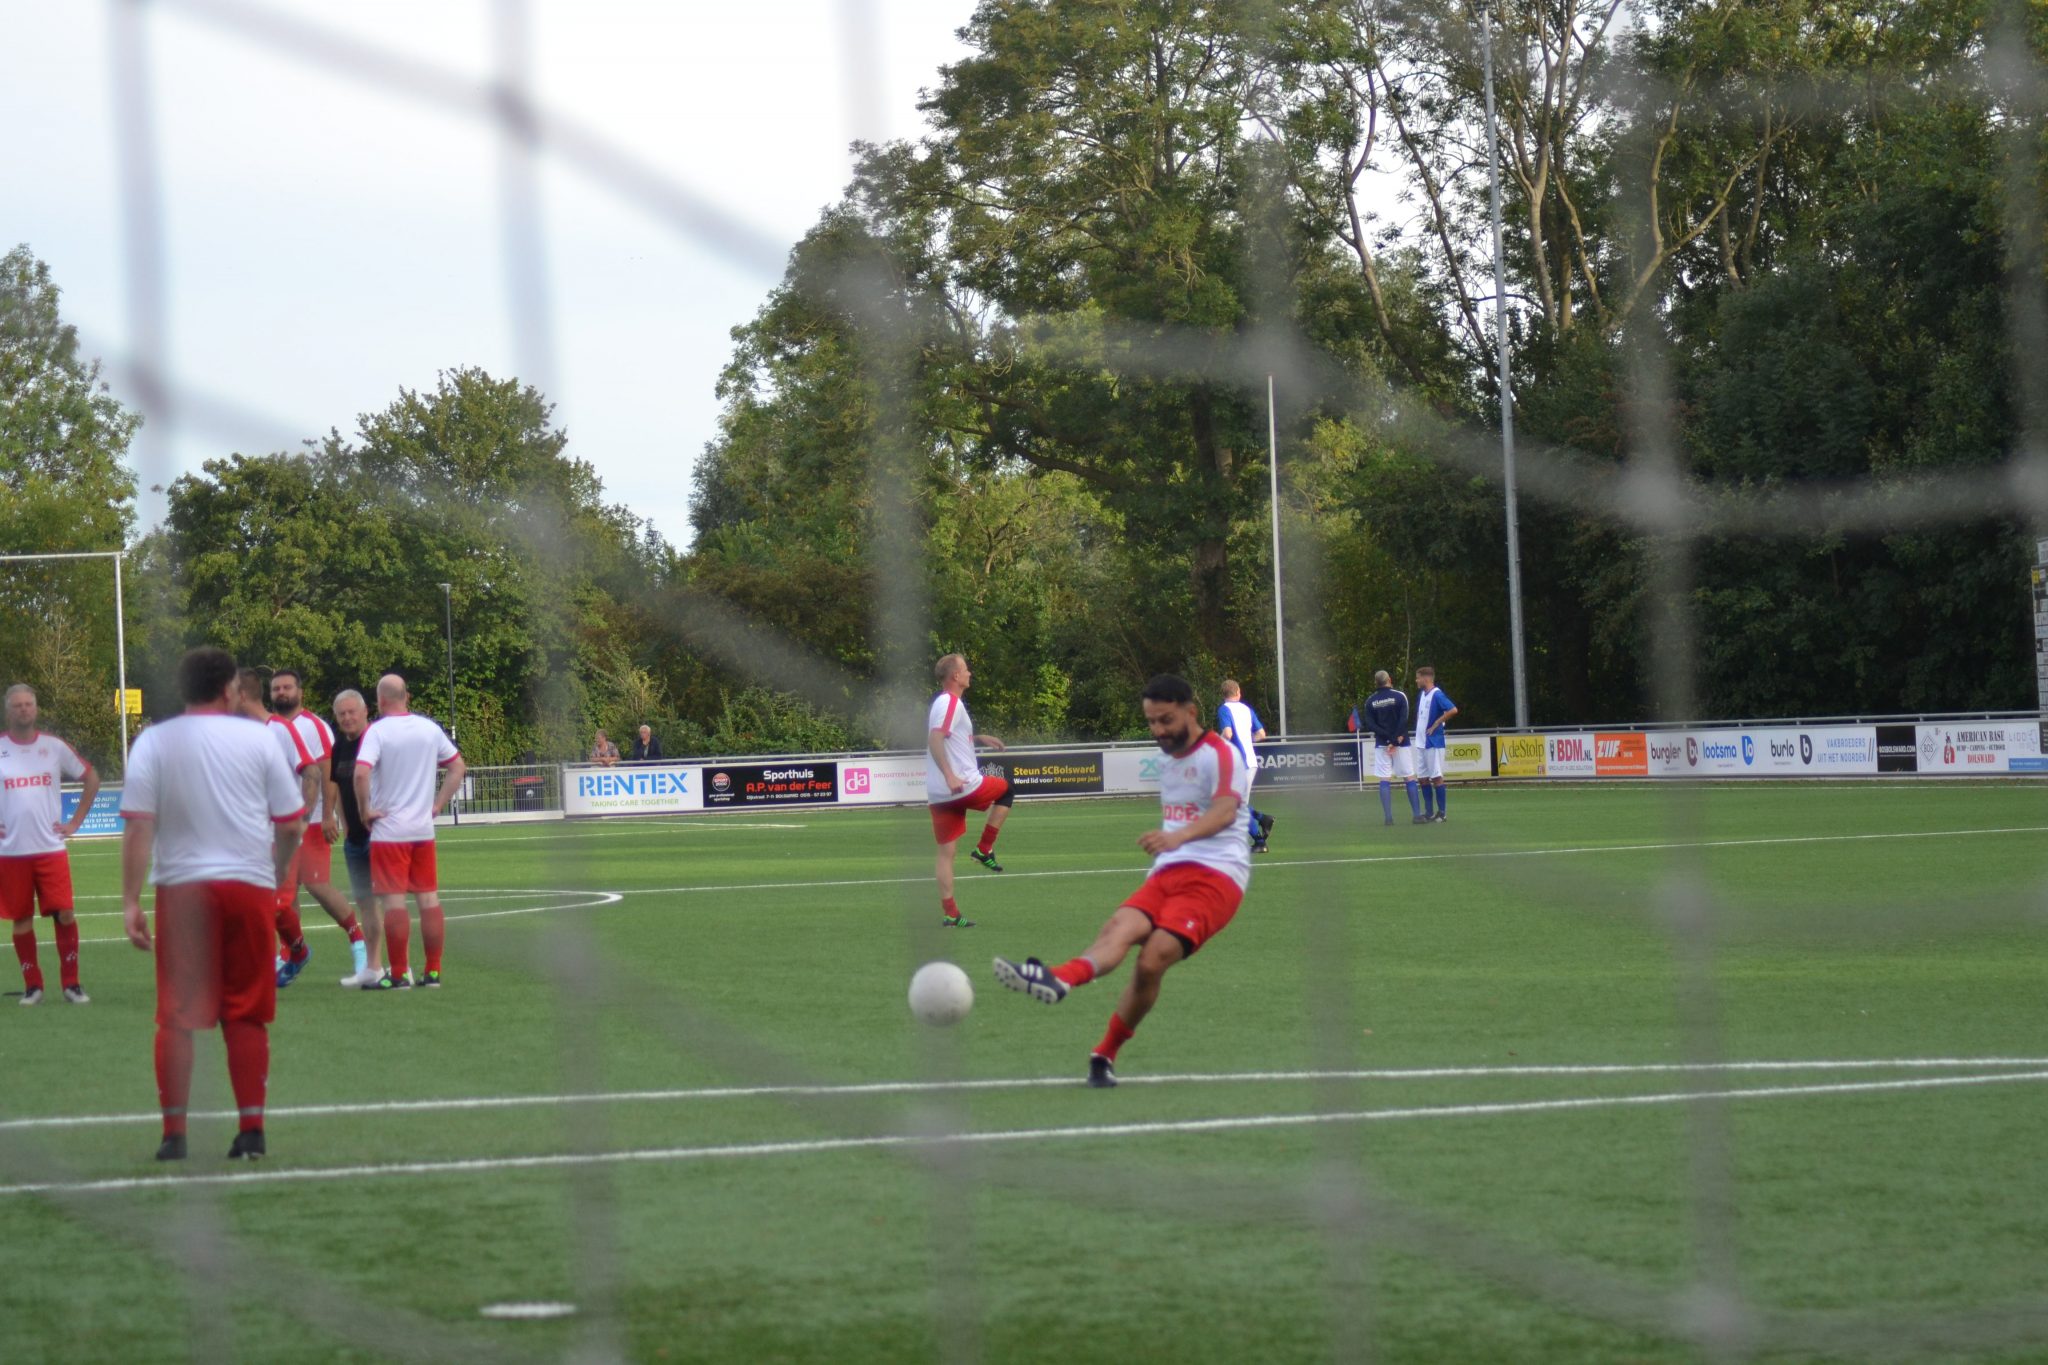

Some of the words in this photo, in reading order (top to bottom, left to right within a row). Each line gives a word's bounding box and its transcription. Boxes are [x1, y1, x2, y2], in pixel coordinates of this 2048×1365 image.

[1957, 731, 1987, 742] AMERICAN
[1989, 730, 2005, 741] BASE
[1651, 742, 1681, 764] burgler
[1702, 741, 1737, 759] lootsma
[1771, 739, 1794, 757] burlo
[1256, 753, 1326, 769] RAPPERS
[1840, 753, 1867, 762] NOORDEN
[763, 769, 814, 782] Sporthuis
[1013, 767, 1040, 776] Steun
[579, 772, 688, 796] RENTEX
[746, 783, 766, 793] A.P.
[768, 783, 787, 792] van
[789, 781, 805, 791] der
[808, 780, 832, 790] Feer
[846, 772, 868, 791] da
[641, 798, 679, 806] TOGETHER
